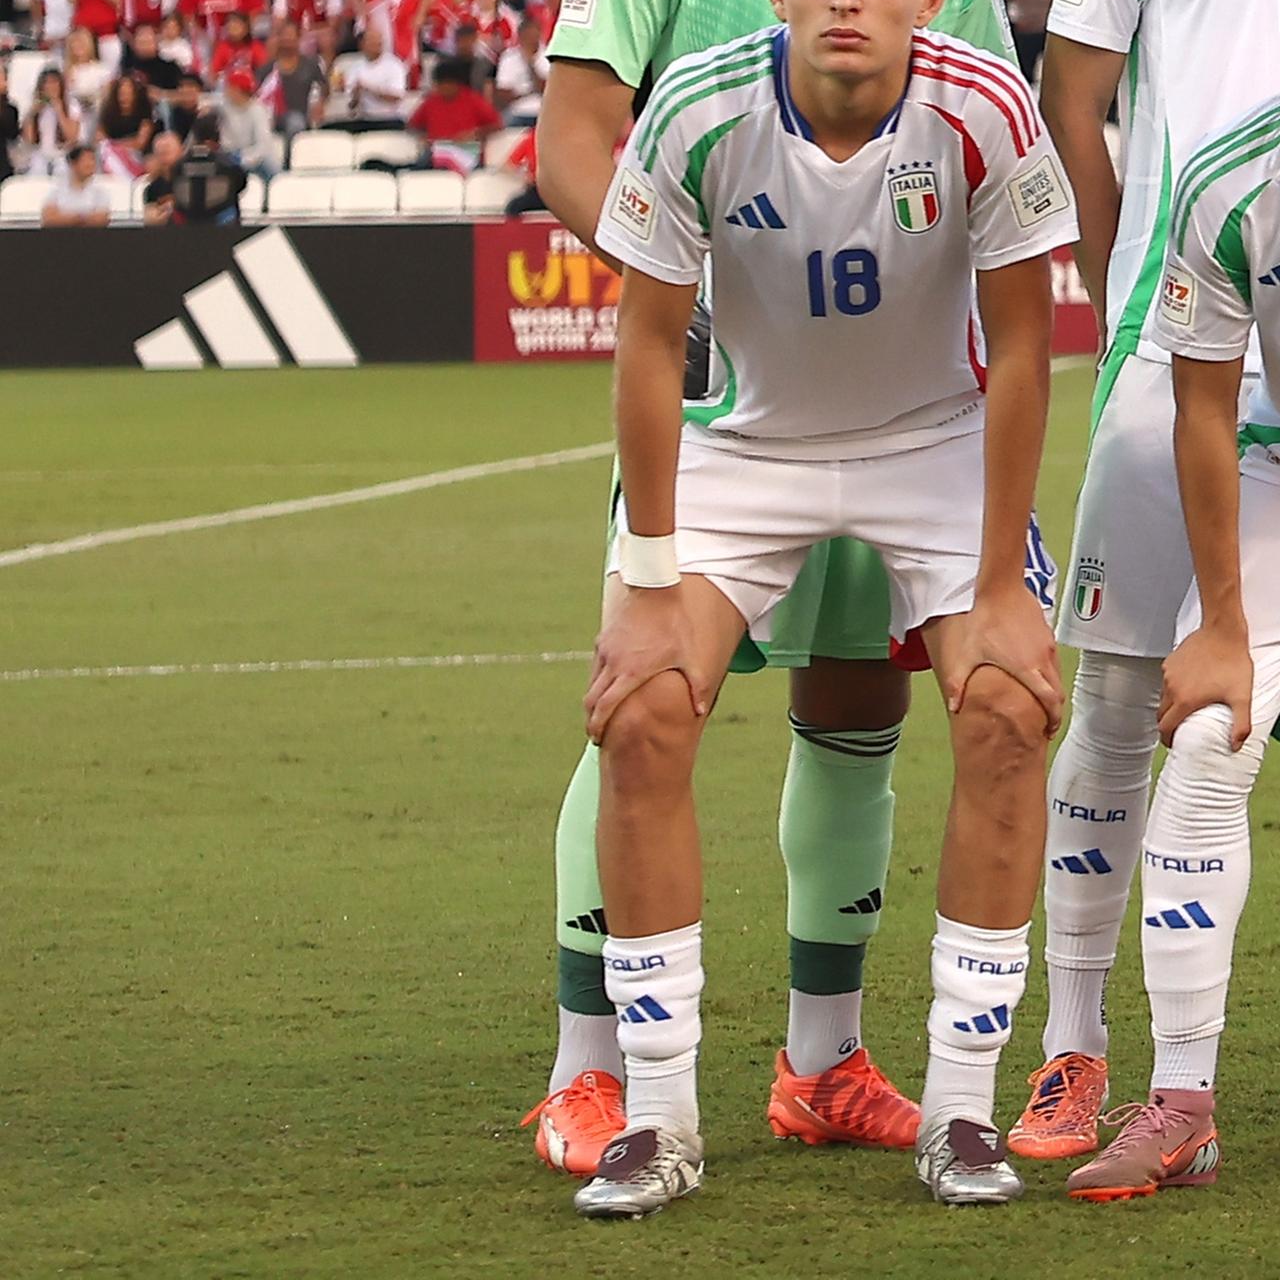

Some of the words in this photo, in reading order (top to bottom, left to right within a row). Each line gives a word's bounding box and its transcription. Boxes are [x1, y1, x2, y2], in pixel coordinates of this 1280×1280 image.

[892, 176, 933, 194] ITALIA
[1020, 176, 1051, 201] UNITES
[806, 249, 882, 318] 18
[1081, 569, 1101, 583] ITALIA
[1052, 797, 1127, 823] ITALIA
[1143, 850, 1224, 874] ITALIA
[957, 954, 1025, 976] ITALIA
